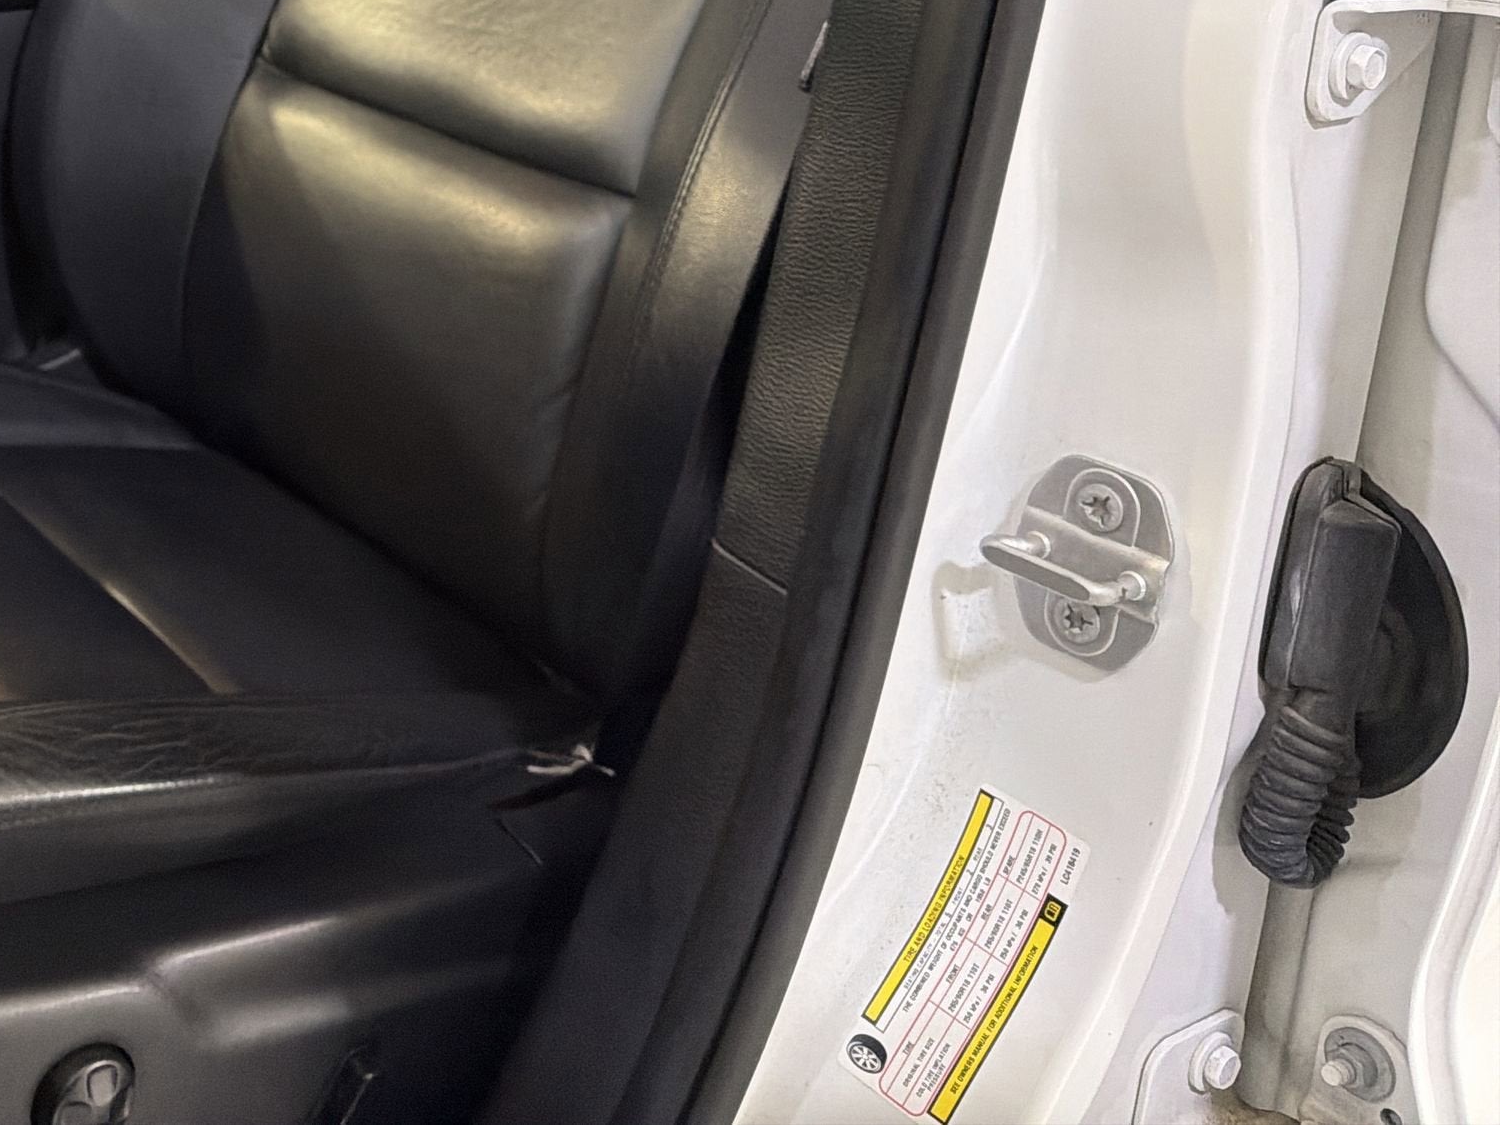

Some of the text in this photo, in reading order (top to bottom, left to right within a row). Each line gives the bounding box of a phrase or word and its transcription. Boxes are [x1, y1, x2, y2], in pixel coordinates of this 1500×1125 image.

[948, 1080, 960, 1095] SEE
[955, 1055, 976, 1083] OWNERS
[969, 1031, 990, 1058] MANUAL
[984, 1017, 998, 1033] FOR
[1011, 943, 1039, 986] INFORMATION
